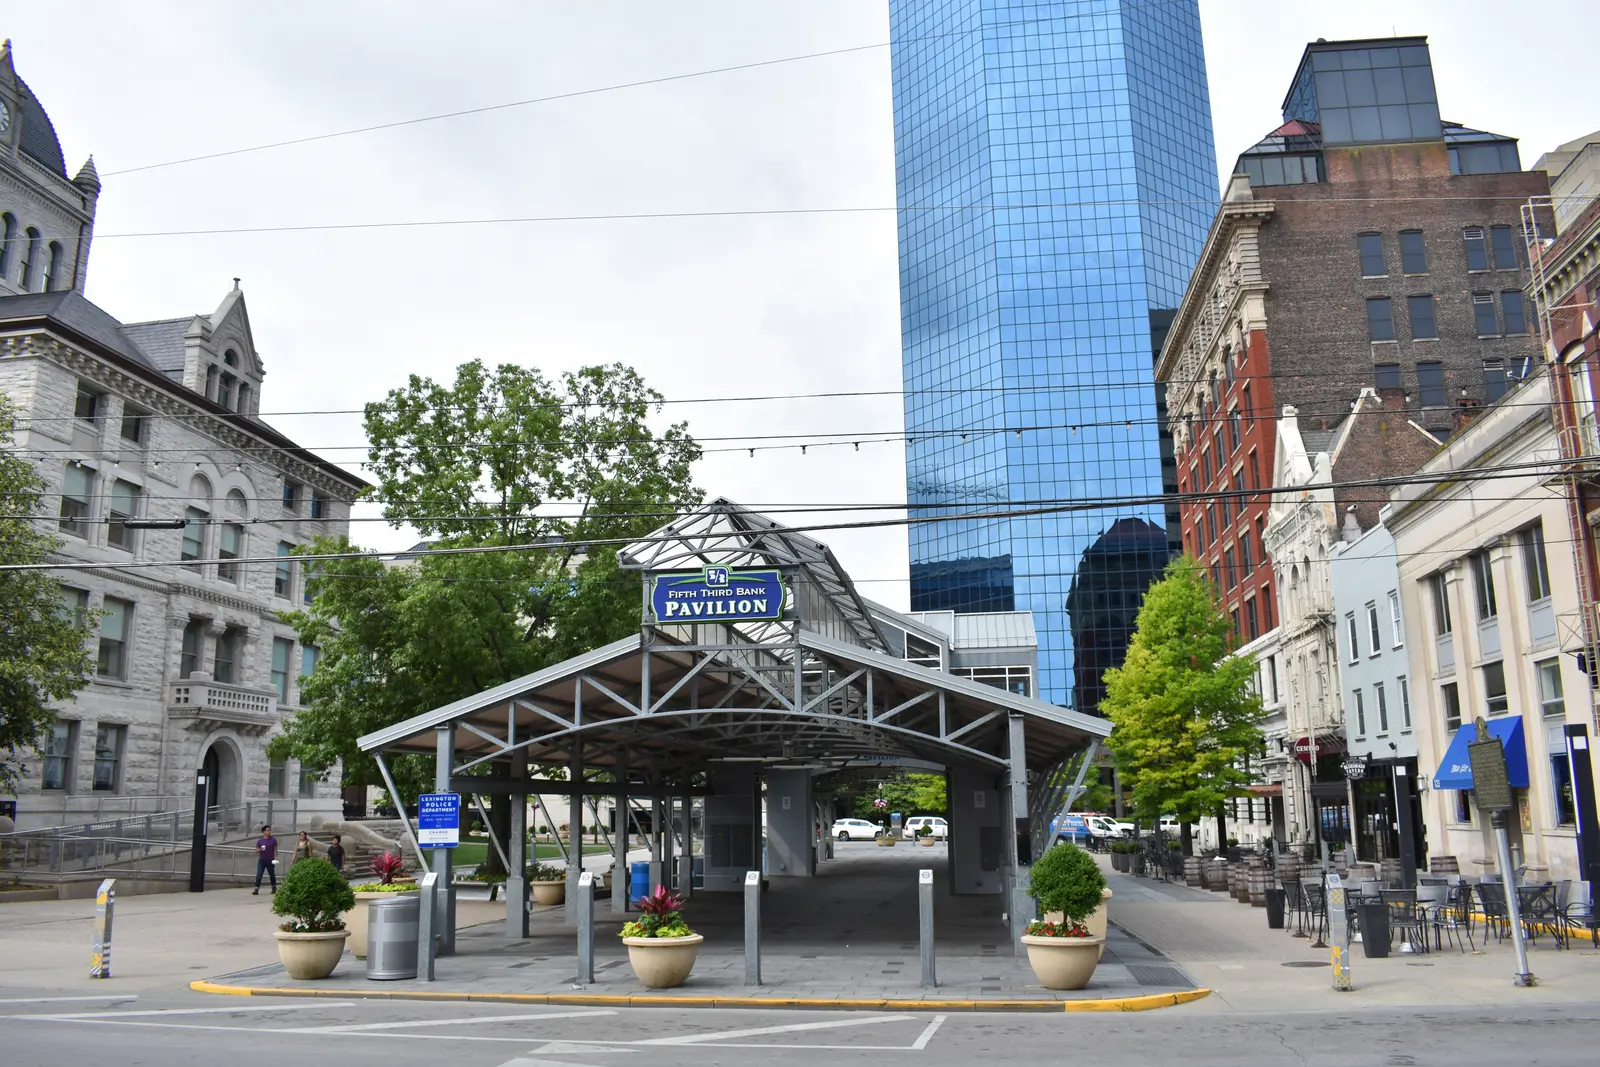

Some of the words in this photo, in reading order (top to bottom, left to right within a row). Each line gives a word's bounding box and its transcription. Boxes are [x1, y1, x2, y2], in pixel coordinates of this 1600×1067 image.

[668, 590, 697, 599] FIFTH
[700, 588, 733, 597] THIRD
[736, 587, 766, 596] BANK
[665, 599, 768, 617] PAVILION
